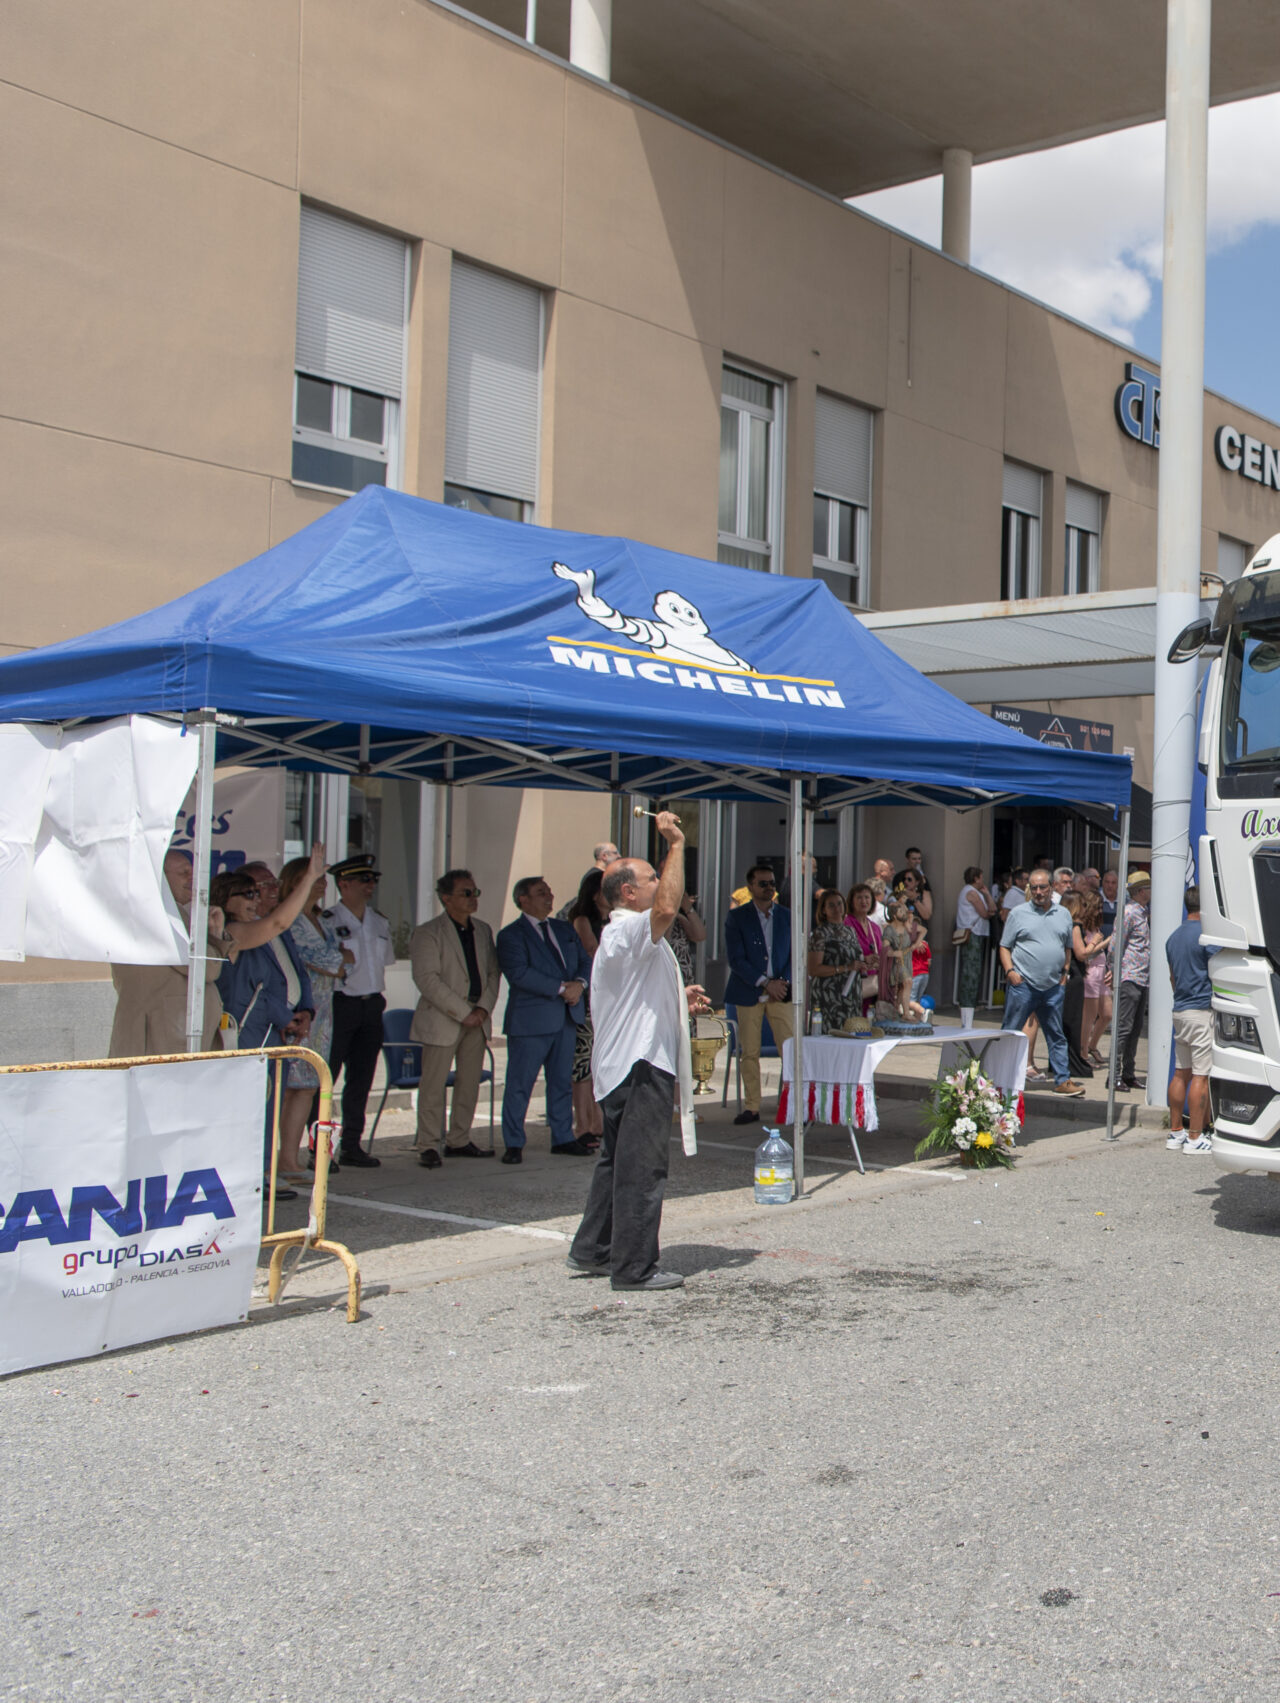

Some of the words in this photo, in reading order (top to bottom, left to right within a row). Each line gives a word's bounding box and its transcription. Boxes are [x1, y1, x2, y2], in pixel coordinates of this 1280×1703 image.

[1114, 362, 1160, 449] CT
[549, 645, 846, 709] MICHELIN
[0, 1167, 236, 1253] ANIA
[62, 1277, 123, 1298] VALLADOD
[130, 1269, 179, 1283] PALENCIA
[187, 1258, 231, 1273] SEGOVIA
[63, 1243, 138, 1275] grupo
[139, 1240, 222, 1267] DIASA
